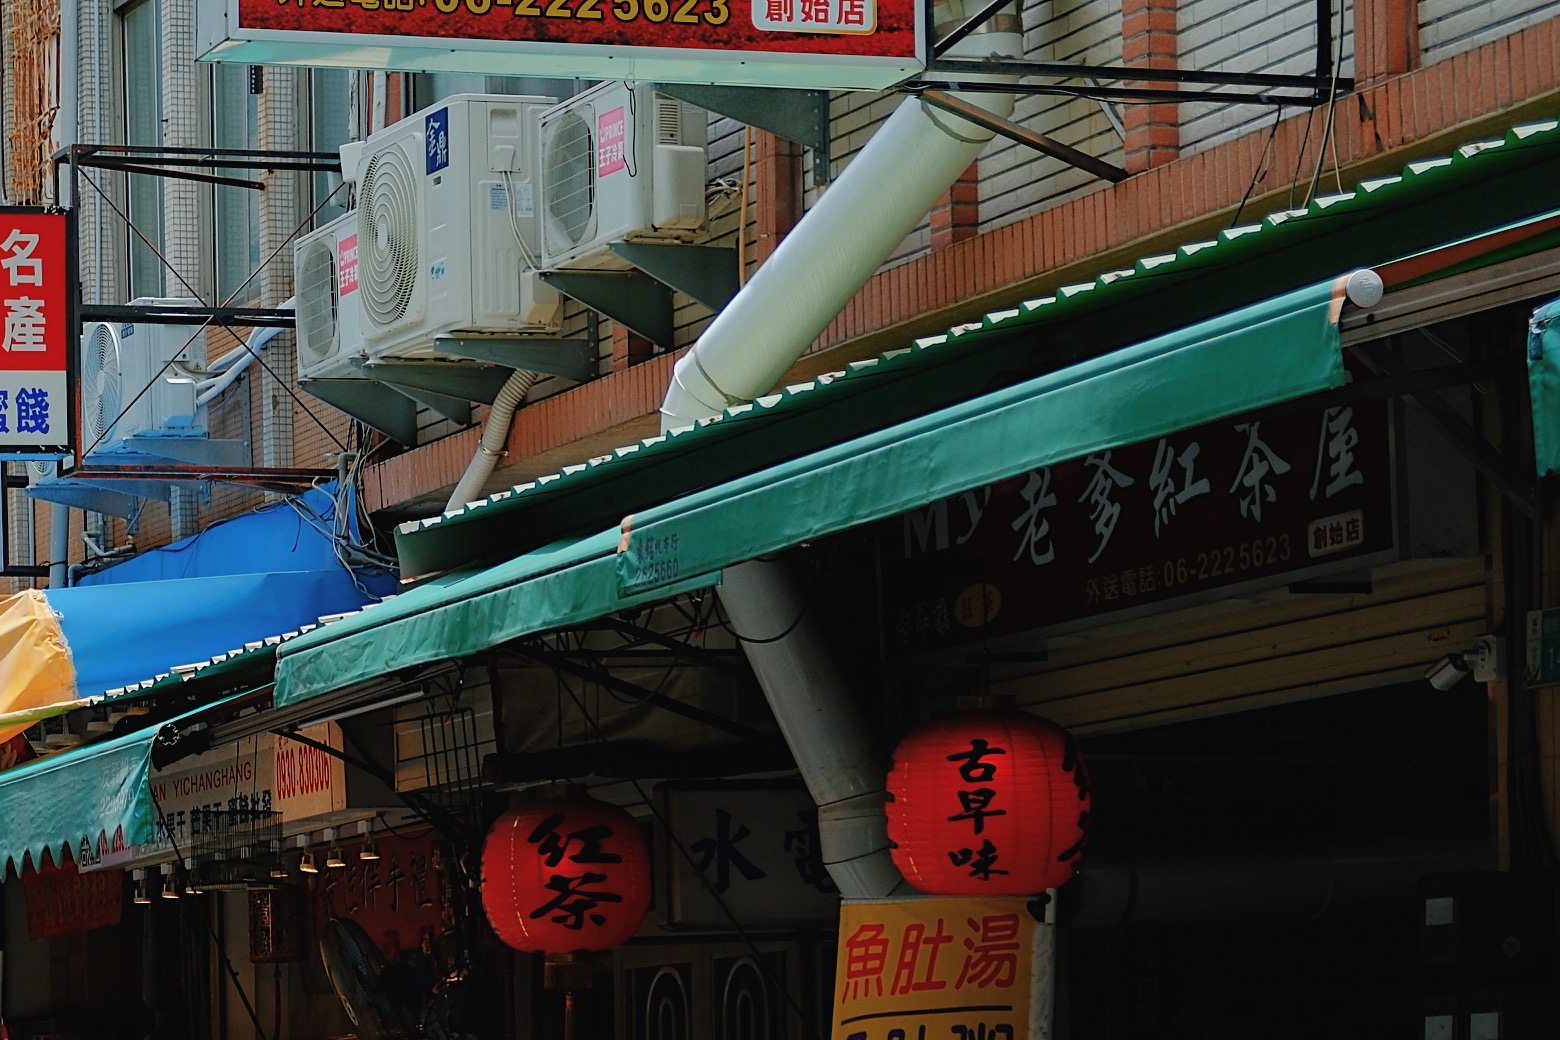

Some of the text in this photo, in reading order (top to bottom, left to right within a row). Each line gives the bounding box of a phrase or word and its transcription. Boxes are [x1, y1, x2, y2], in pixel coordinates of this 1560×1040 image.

[605, 121, 624, 141] PRINCE
[0, 228, 47, 353] 名產
[1313, 517, 1364, 549] 創始店
[173, 761, 252, 799] YICHANGHANG
[946, 738, 1009, 881] 古早味
[841, 913, 1021, 1001] 魚肚湯
